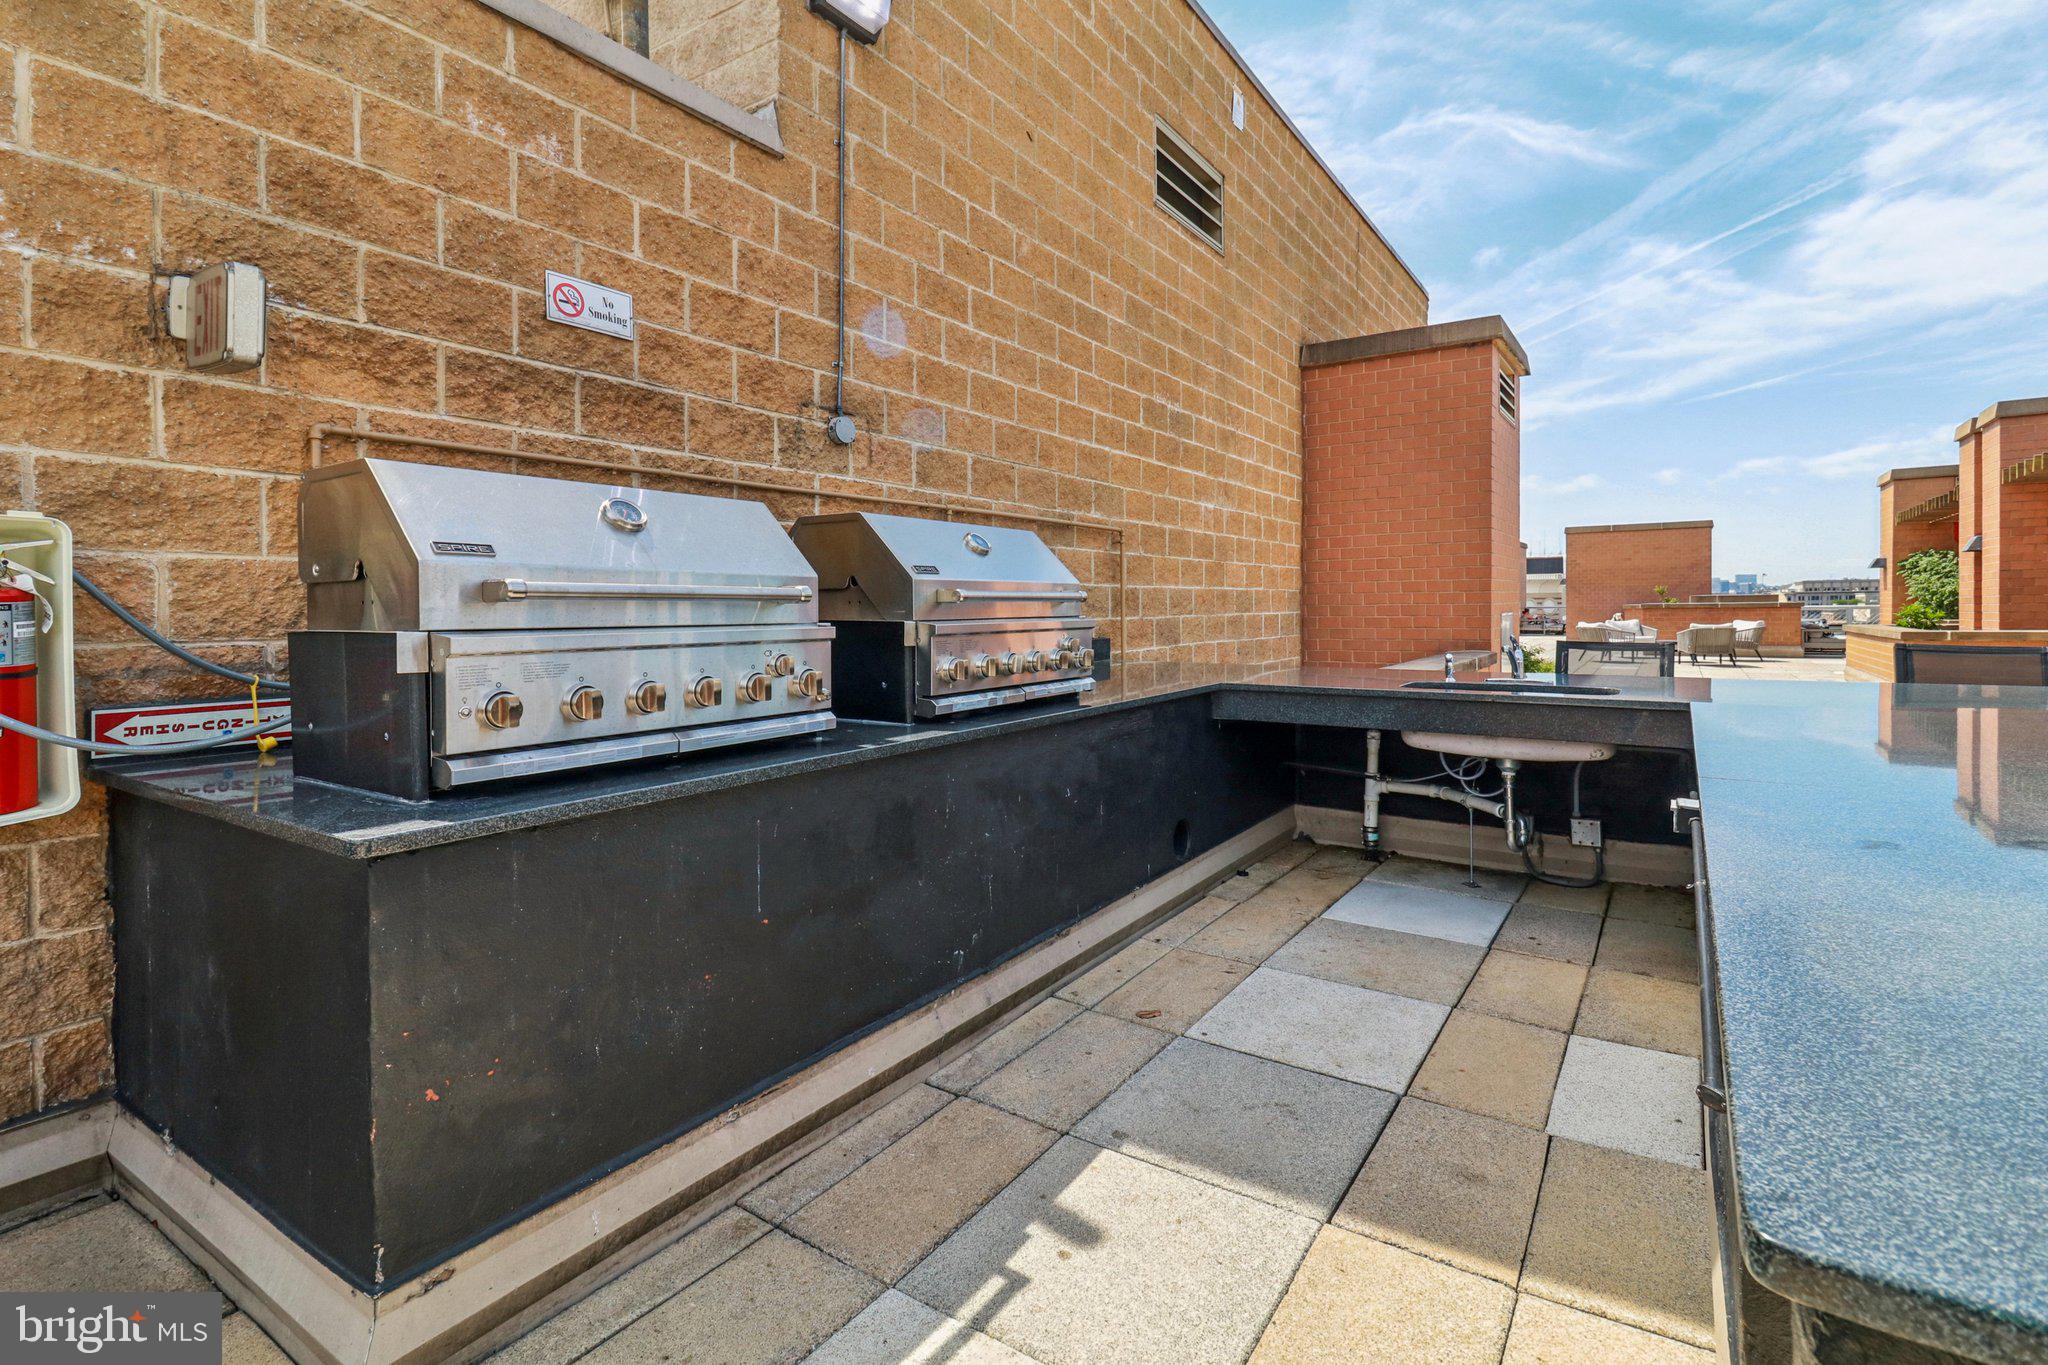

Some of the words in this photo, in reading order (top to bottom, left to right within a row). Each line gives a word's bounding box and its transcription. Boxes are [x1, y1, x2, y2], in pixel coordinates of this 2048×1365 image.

[602, 296, 614, 310] No
[194, 275, 222, 357] EXIT
[588, 306, 627, 328] Smoking
